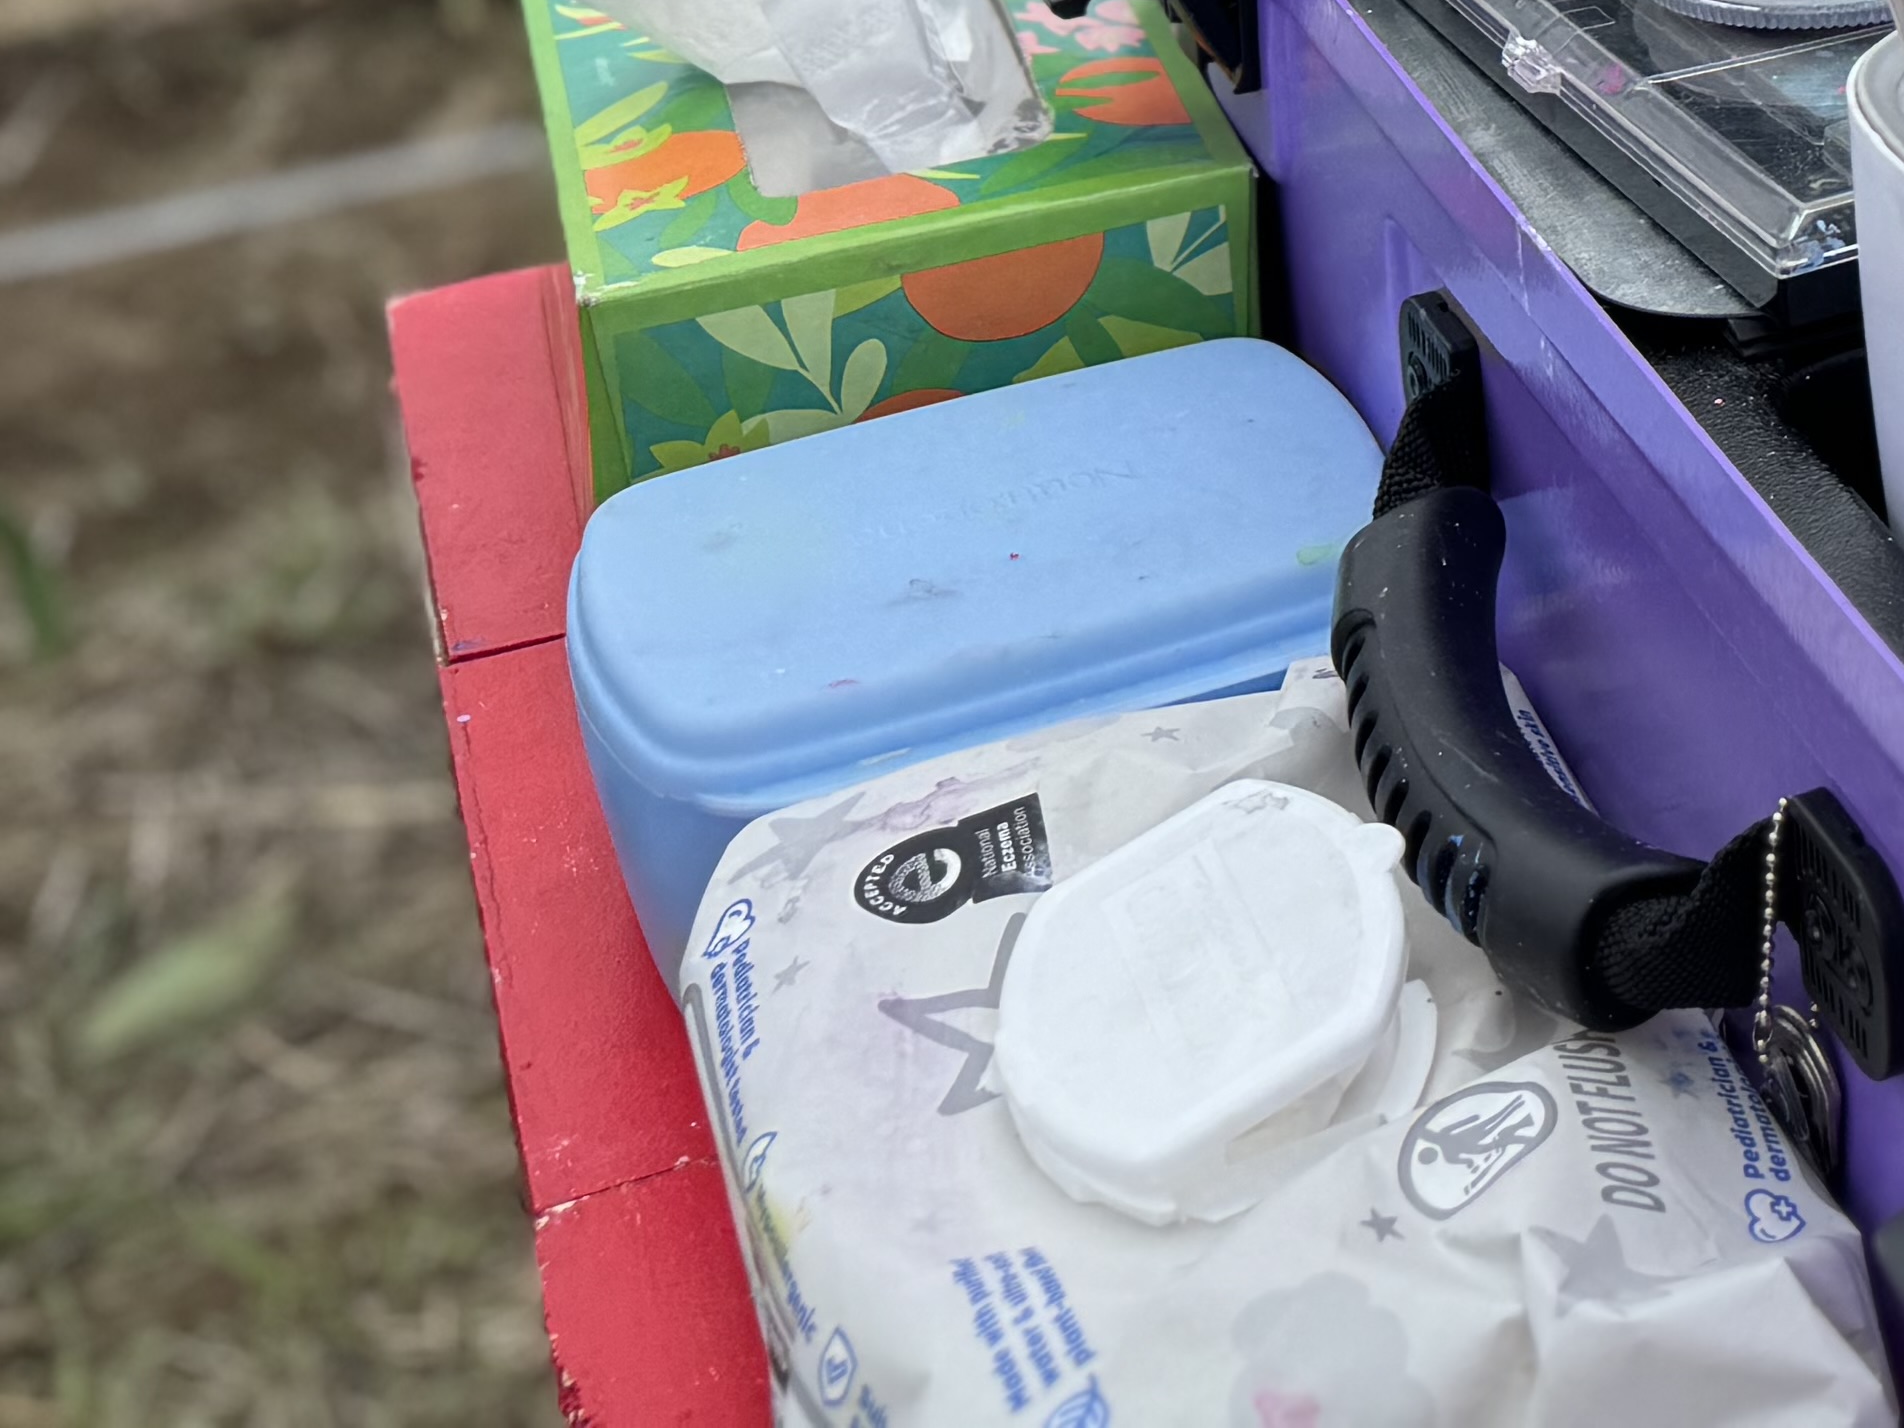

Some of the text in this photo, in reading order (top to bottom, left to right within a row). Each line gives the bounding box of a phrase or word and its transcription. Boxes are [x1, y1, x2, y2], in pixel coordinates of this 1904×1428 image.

[975, 827, 999, 878] National
[996, 821, 1017, 872] Eczema
[863, 853, 907, 916] ACCEPTED
[732, 937, 760, 1044] Pediatrician
[1553, 1029, 1666, 1213] DO NOT FLUSH
[1698, 1040, 1766, 1180] Pediatrician &
[992, 1347, 1032, 1414] Made
[1022, 1324, 1061, 1389] water
